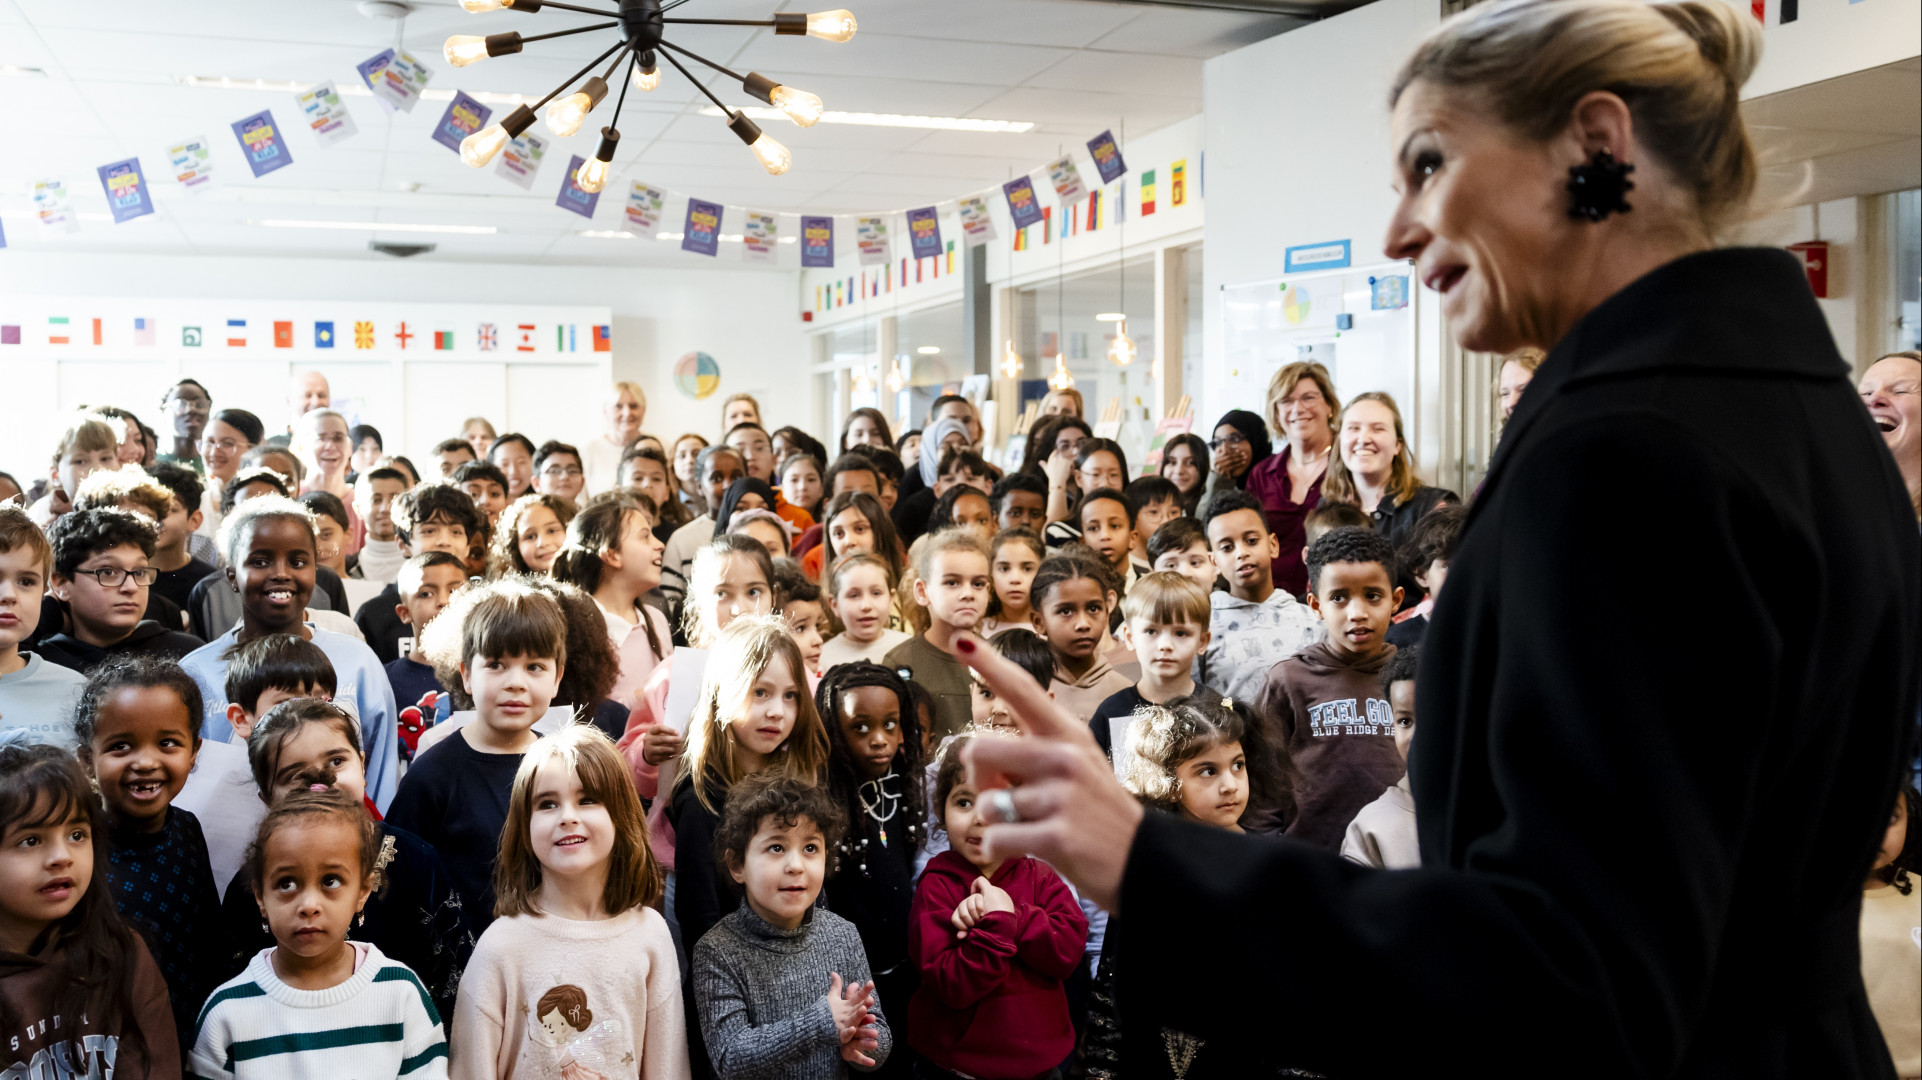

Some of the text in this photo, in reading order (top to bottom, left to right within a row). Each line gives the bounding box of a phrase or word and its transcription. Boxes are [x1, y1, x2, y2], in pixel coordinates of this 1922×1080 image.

[1308, 698, 1365, 727] FEEL
[1312, 726, 1339, 736] BLUE
[1346, 725, 1378, 735] RIDGE
